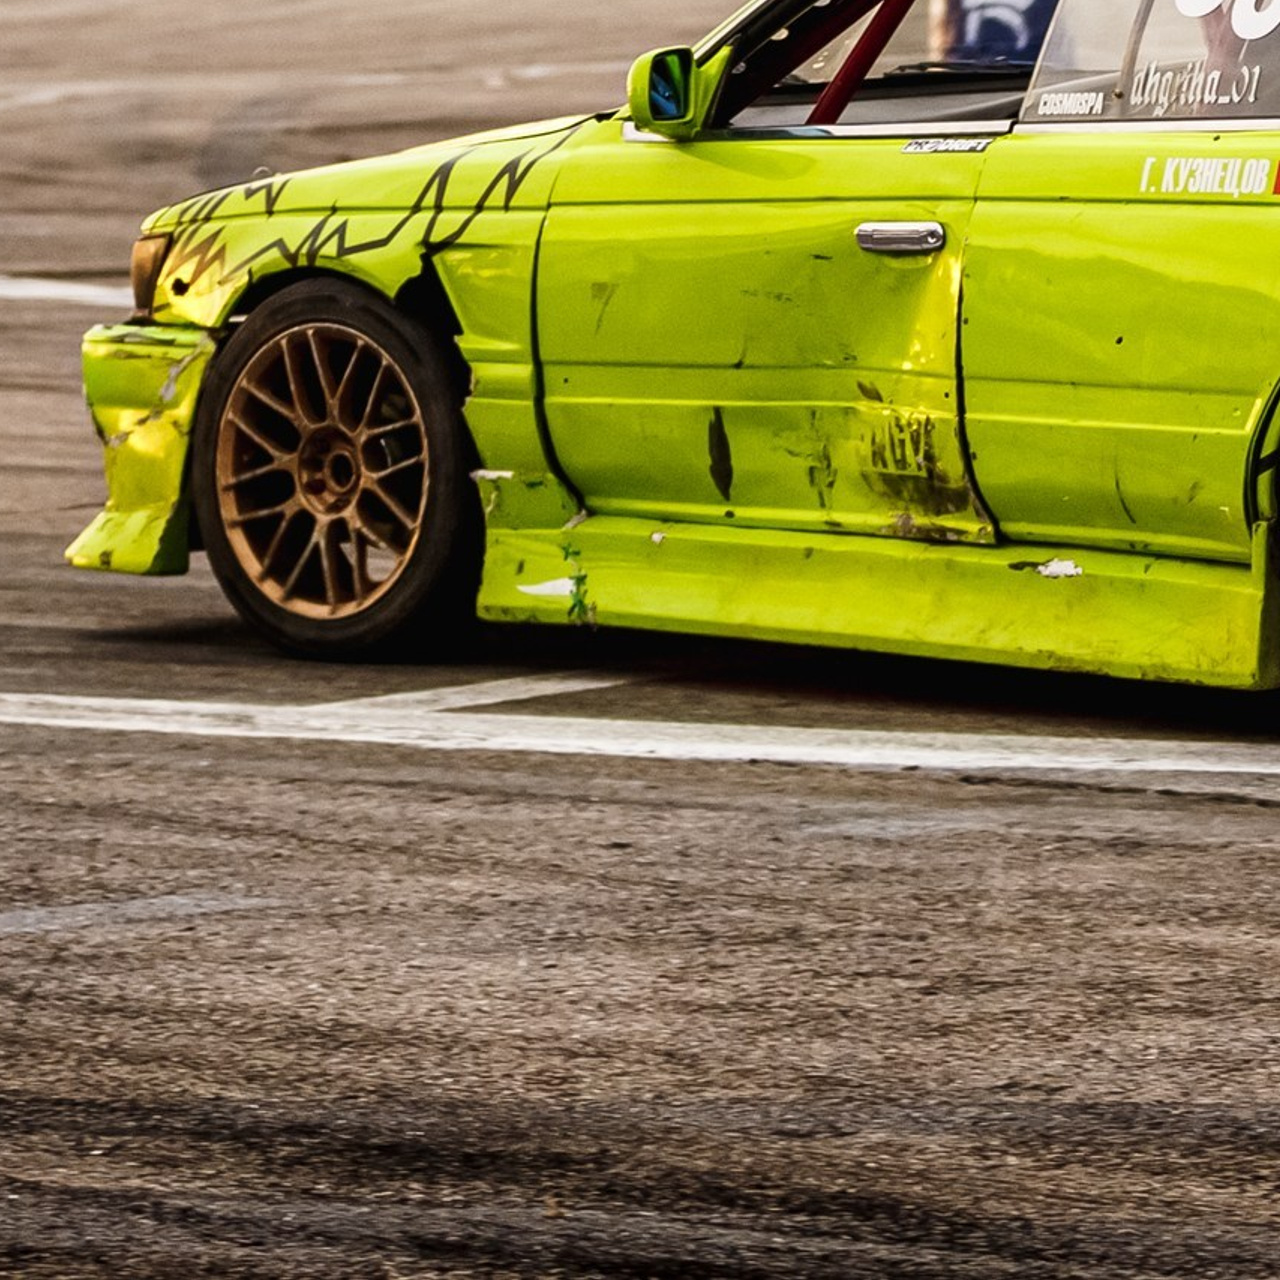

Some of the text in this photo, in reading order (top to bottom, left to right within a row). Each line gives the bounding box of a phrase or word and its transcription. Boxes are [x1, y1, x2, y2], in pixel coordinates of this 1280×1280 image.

[1038, 92, 1104, 115] COSMOSPA
[1139, 157, 1270, 199] Г. КУЗНЕЦОВ
